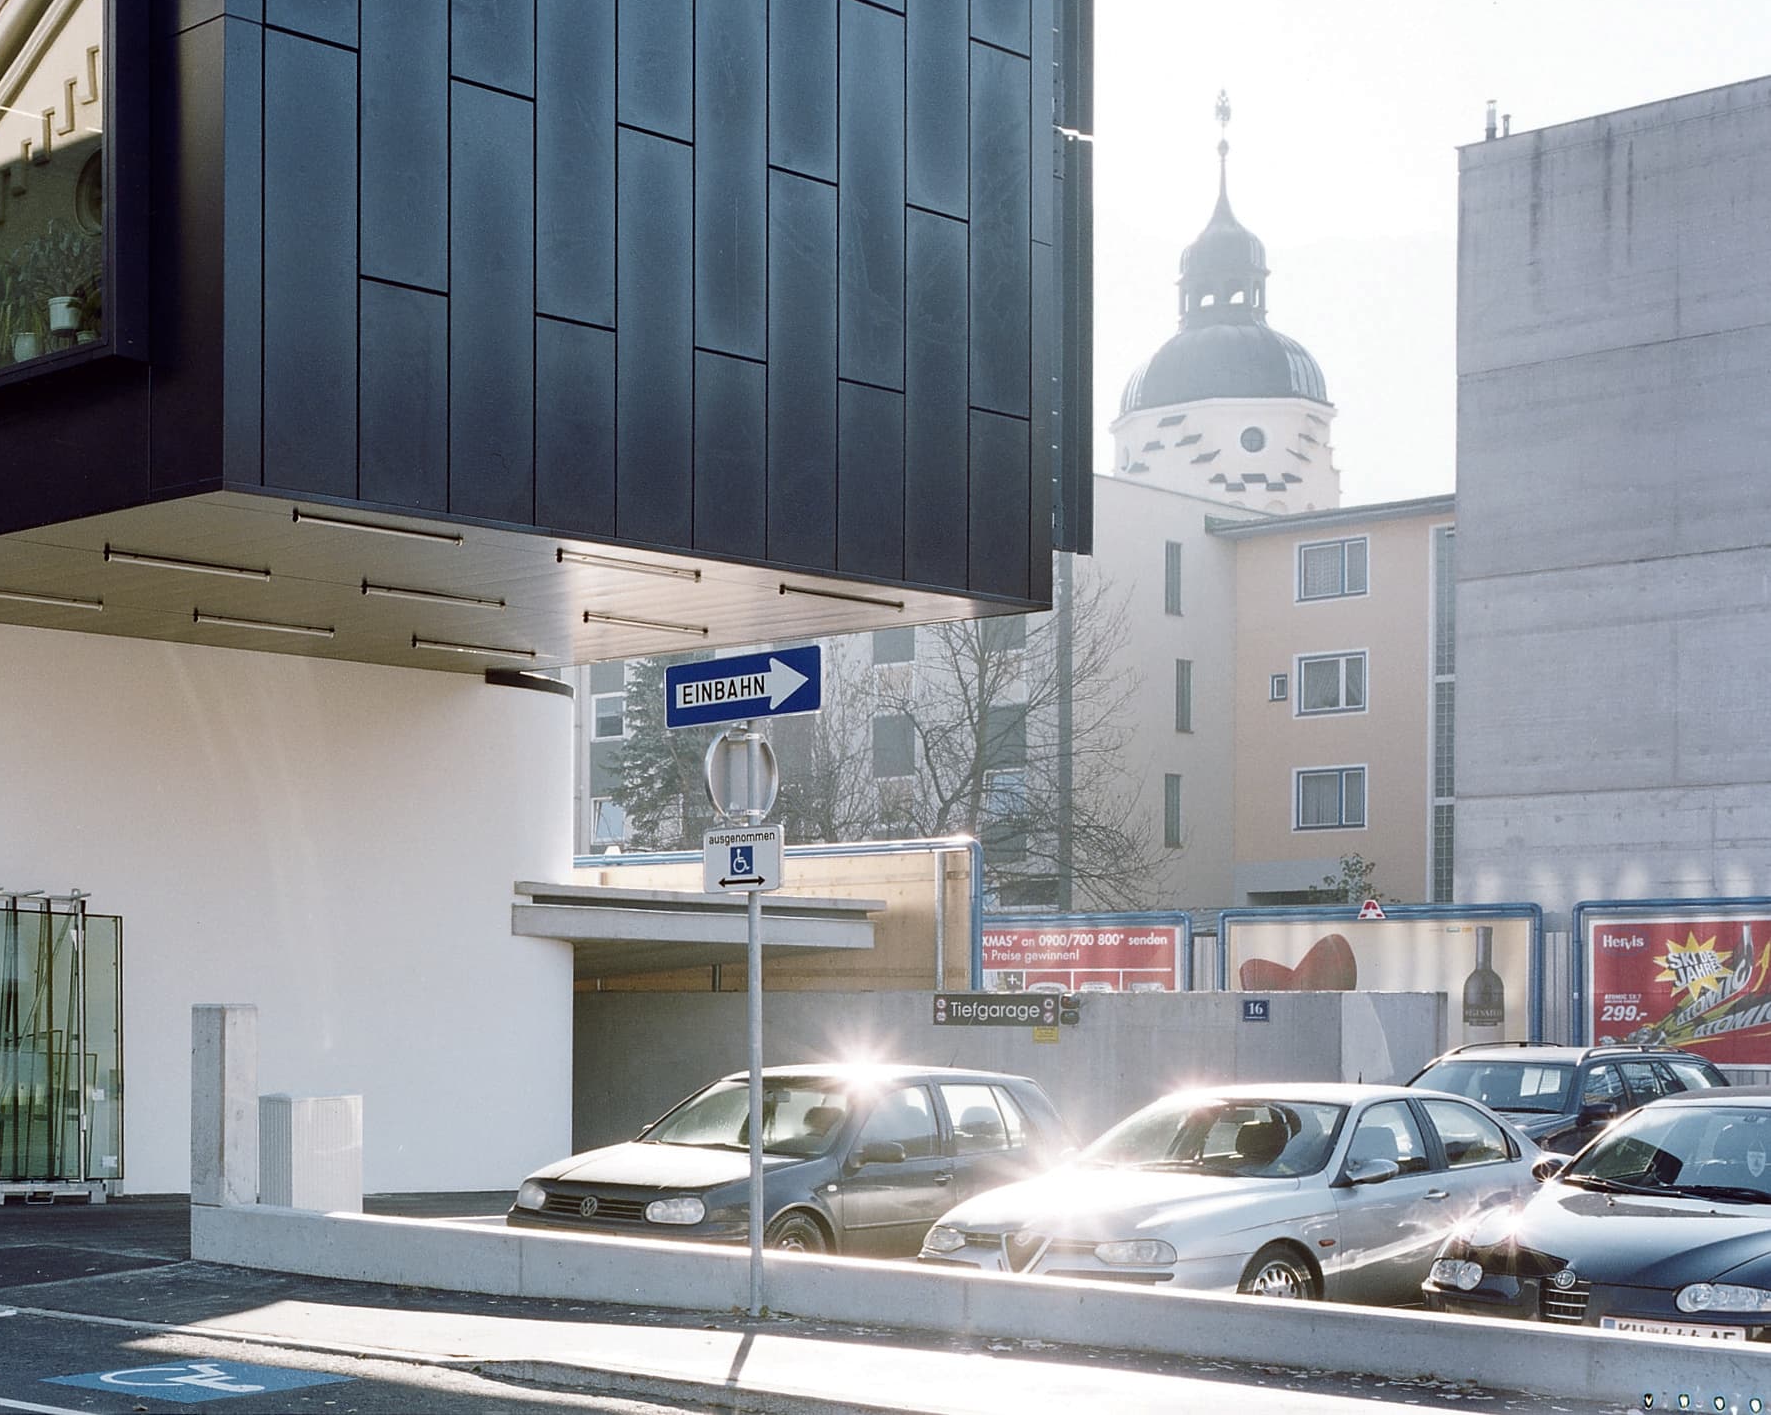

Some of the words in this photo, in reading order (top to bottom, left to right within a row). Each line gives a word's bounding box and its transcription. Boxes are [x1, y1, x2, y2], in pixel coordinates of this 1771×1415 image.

[683, 674, 765, 705] EINBAHN
[708, 832, 775, 846] ausgenommen
[1021, 937, 1035, 947] an
[1128, 931, 1167, 947] senden
[1603, 934, 1645, 950] Hervis
[992, 948, 1021, 962] Preise
[1024, 948, 1079, 964] gewinnen!
[1667, 951, 1698, 970] SKI
[950, 1001, 1040, 1021] Tiefgarage
[1249, 1002, 1263, 1015] 16
